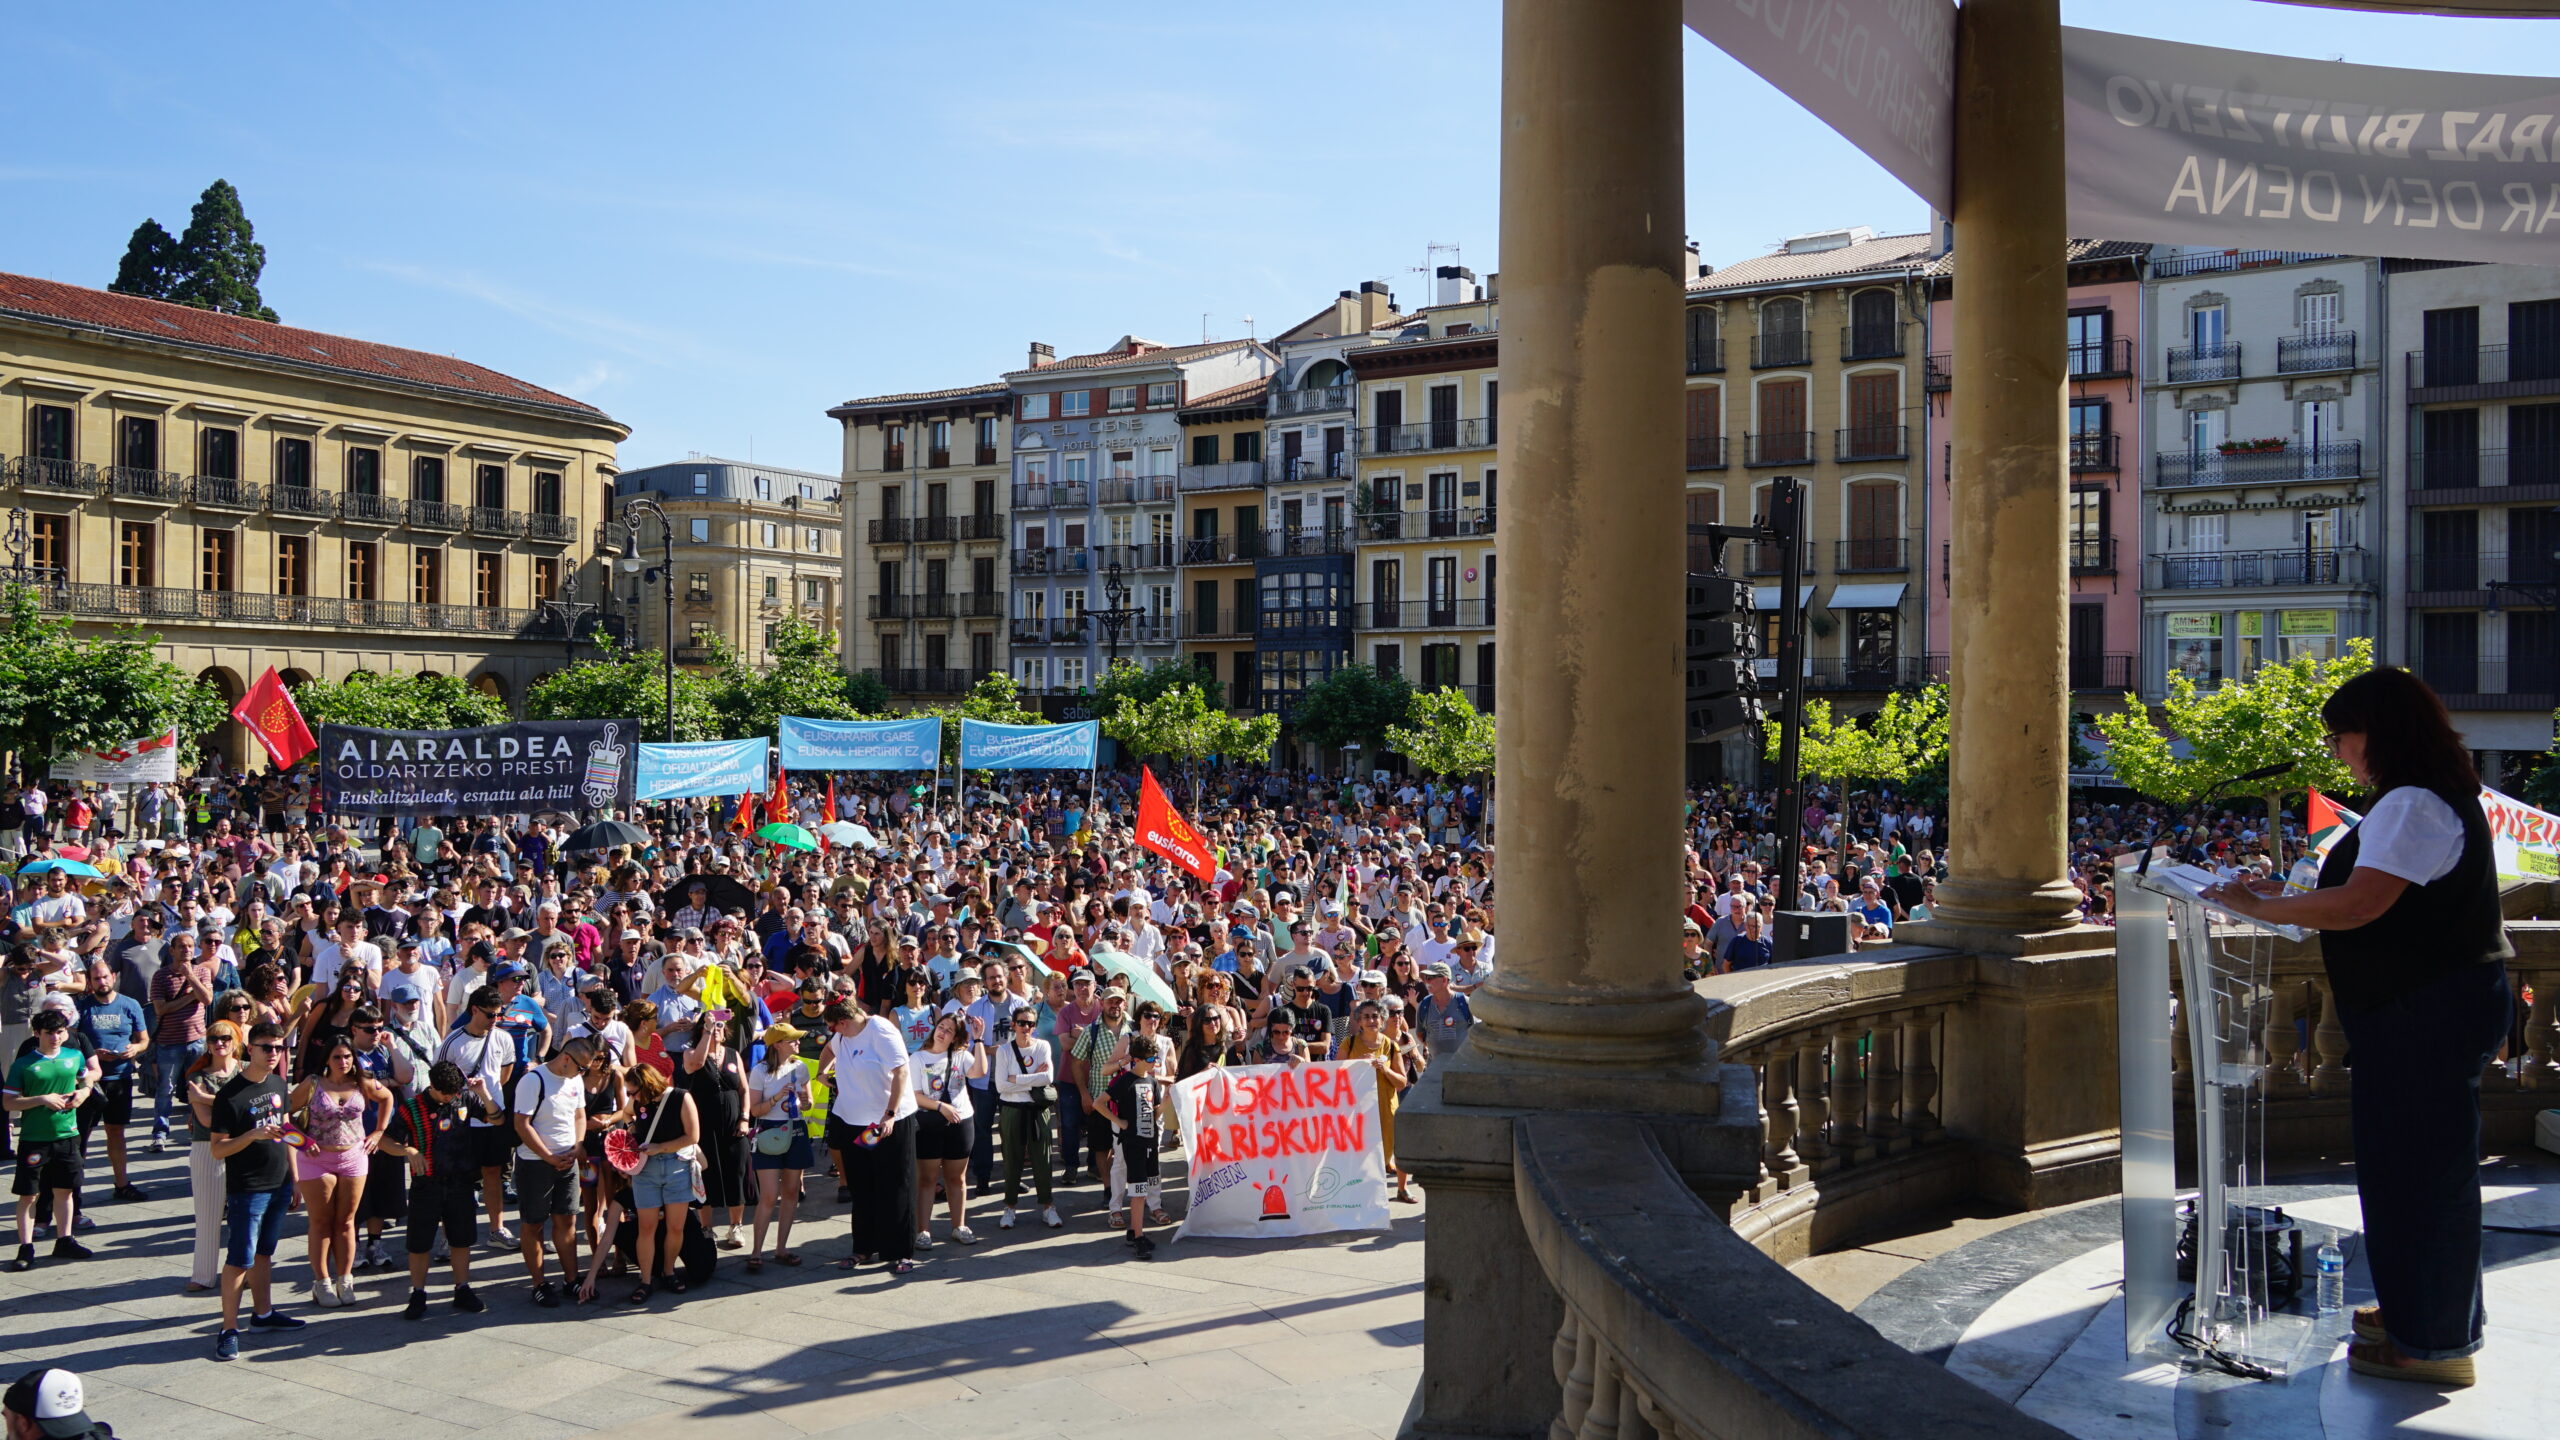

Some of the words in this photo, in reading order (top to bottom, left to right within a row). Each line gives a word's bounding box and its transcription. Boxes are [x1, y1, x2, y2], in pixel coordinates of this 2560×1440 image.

[1052, 423, 1079, 436] EL
[1088, 418, 1143, 434] CISNE
[2174, 616, 2216, 627] AMNESTY
[803, 730, 880, 742] EUSKARARIK
[882, 731, 915, 742] GABE
[338, 736, 574, 761] AIARALDEA
[798, 745, 846, 757] EUSKAL
[848, 745, 902, 757] HERRIRIK
[905, 745, 920, 757] EZ
[969, 745, 1026, 757] EUSKARA
[1054, 745, 1090, 757] DADIN
[338, 762, 493, 779] OLDARTZEKO
[501, 760, 574, 776] PREST!
[714, 773, 752, 786] BATEAN
[338, 789, 458, 806] Euskaltzaleak,
[463, 786, 516, 802] esnatu
[519, 785, 545, 801] ala
[547, 784, 574, 800] hil!
[1147, 829, 1200, 870] euskaraz
